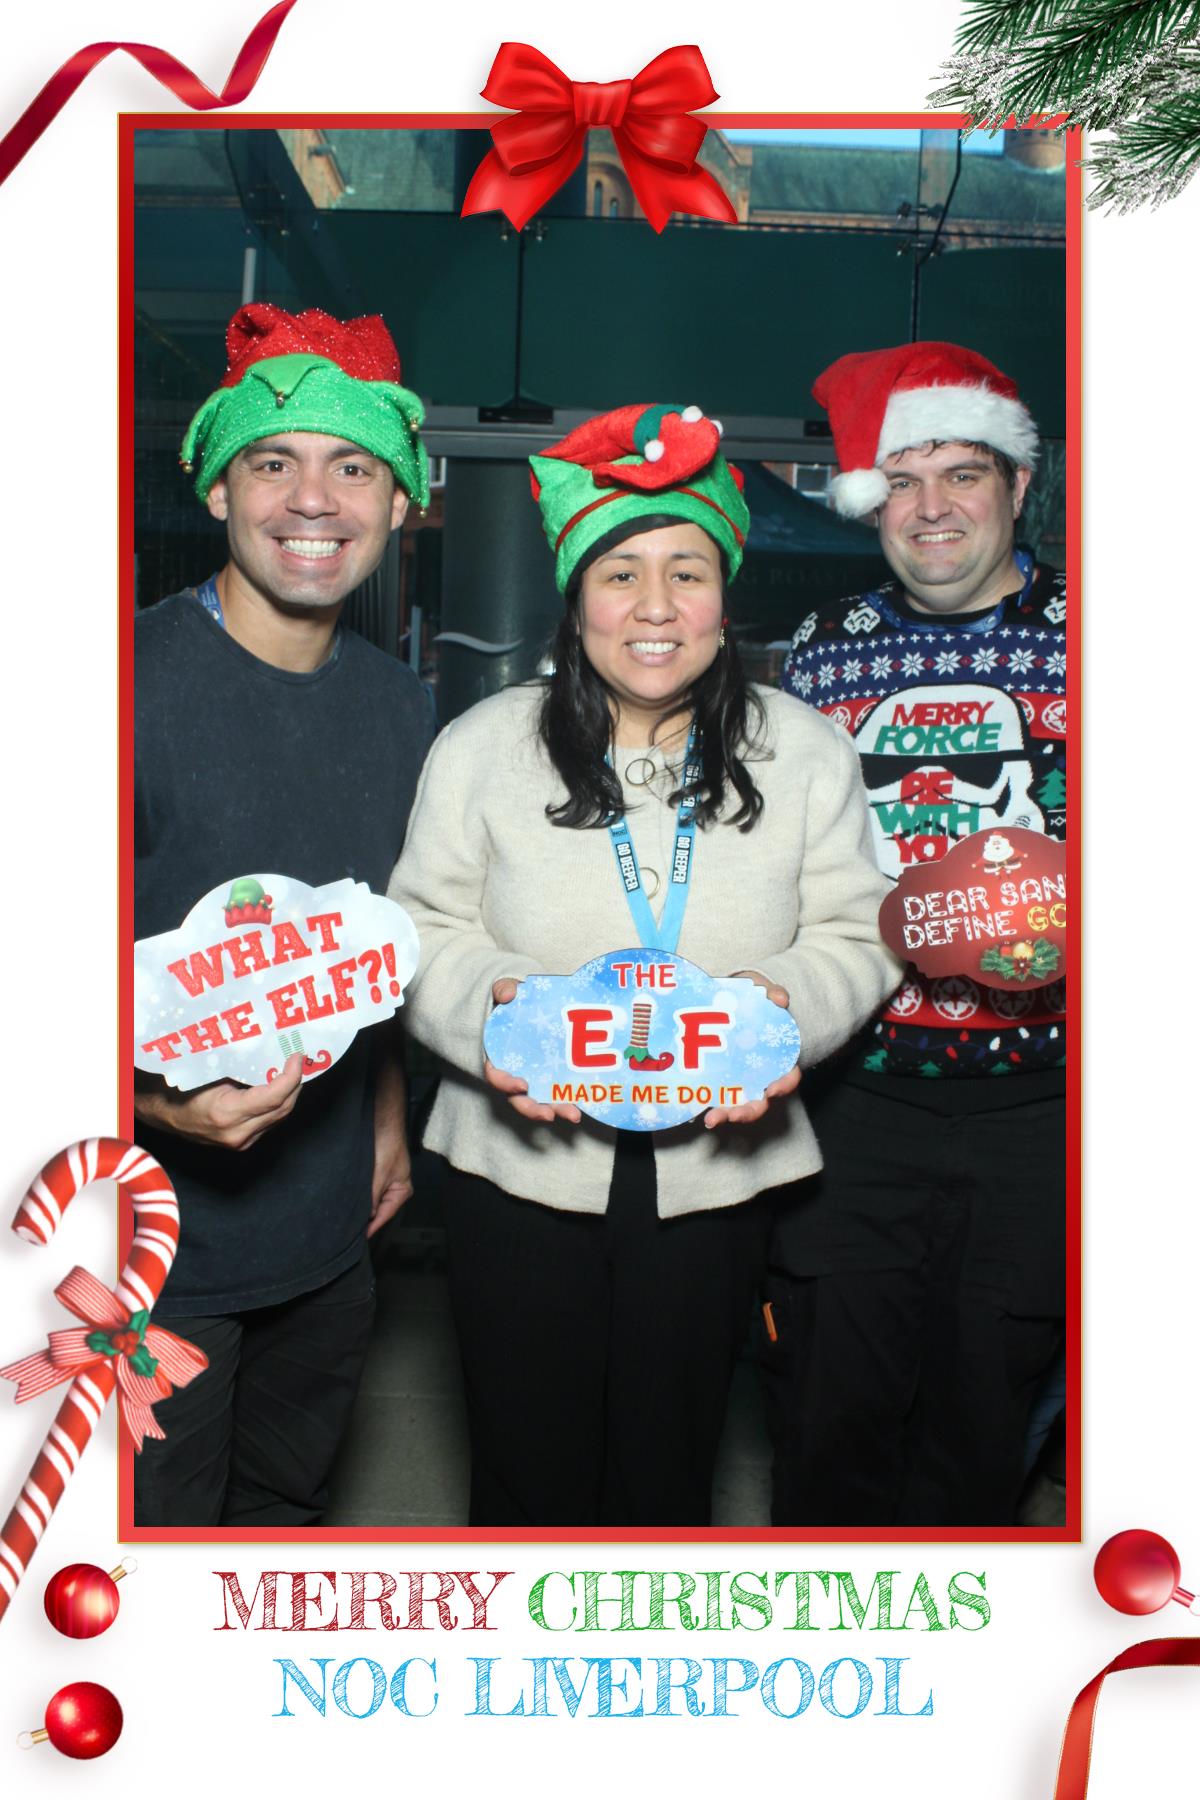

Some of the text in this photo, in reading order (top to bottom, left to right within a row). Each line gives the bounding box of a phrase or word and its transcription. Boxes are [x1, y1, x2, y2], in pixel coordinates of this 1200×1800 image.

[893, 702, 994, 726] MERRY
[874, 723, 1001, 754] FORCE
[901, 771, 955, 805] BE
[875, 802, 980, 836] WITH
[672, 836, 691, 882] GO DEEPER
[893, 833, 950, 864] YO
[616, 843, 639, 891] GO DEEPER
[904, 873, 1067, 921] DEAR SAN
[904, 910, 1017, 949] DEFINE
[167, 912, 343, 998] WHAT
[612, 963, 677, 988] THE
[141, 942, 400, 1062] THE ELF?!
[552, 1083, 743, 1105] MADE ME DO IT
